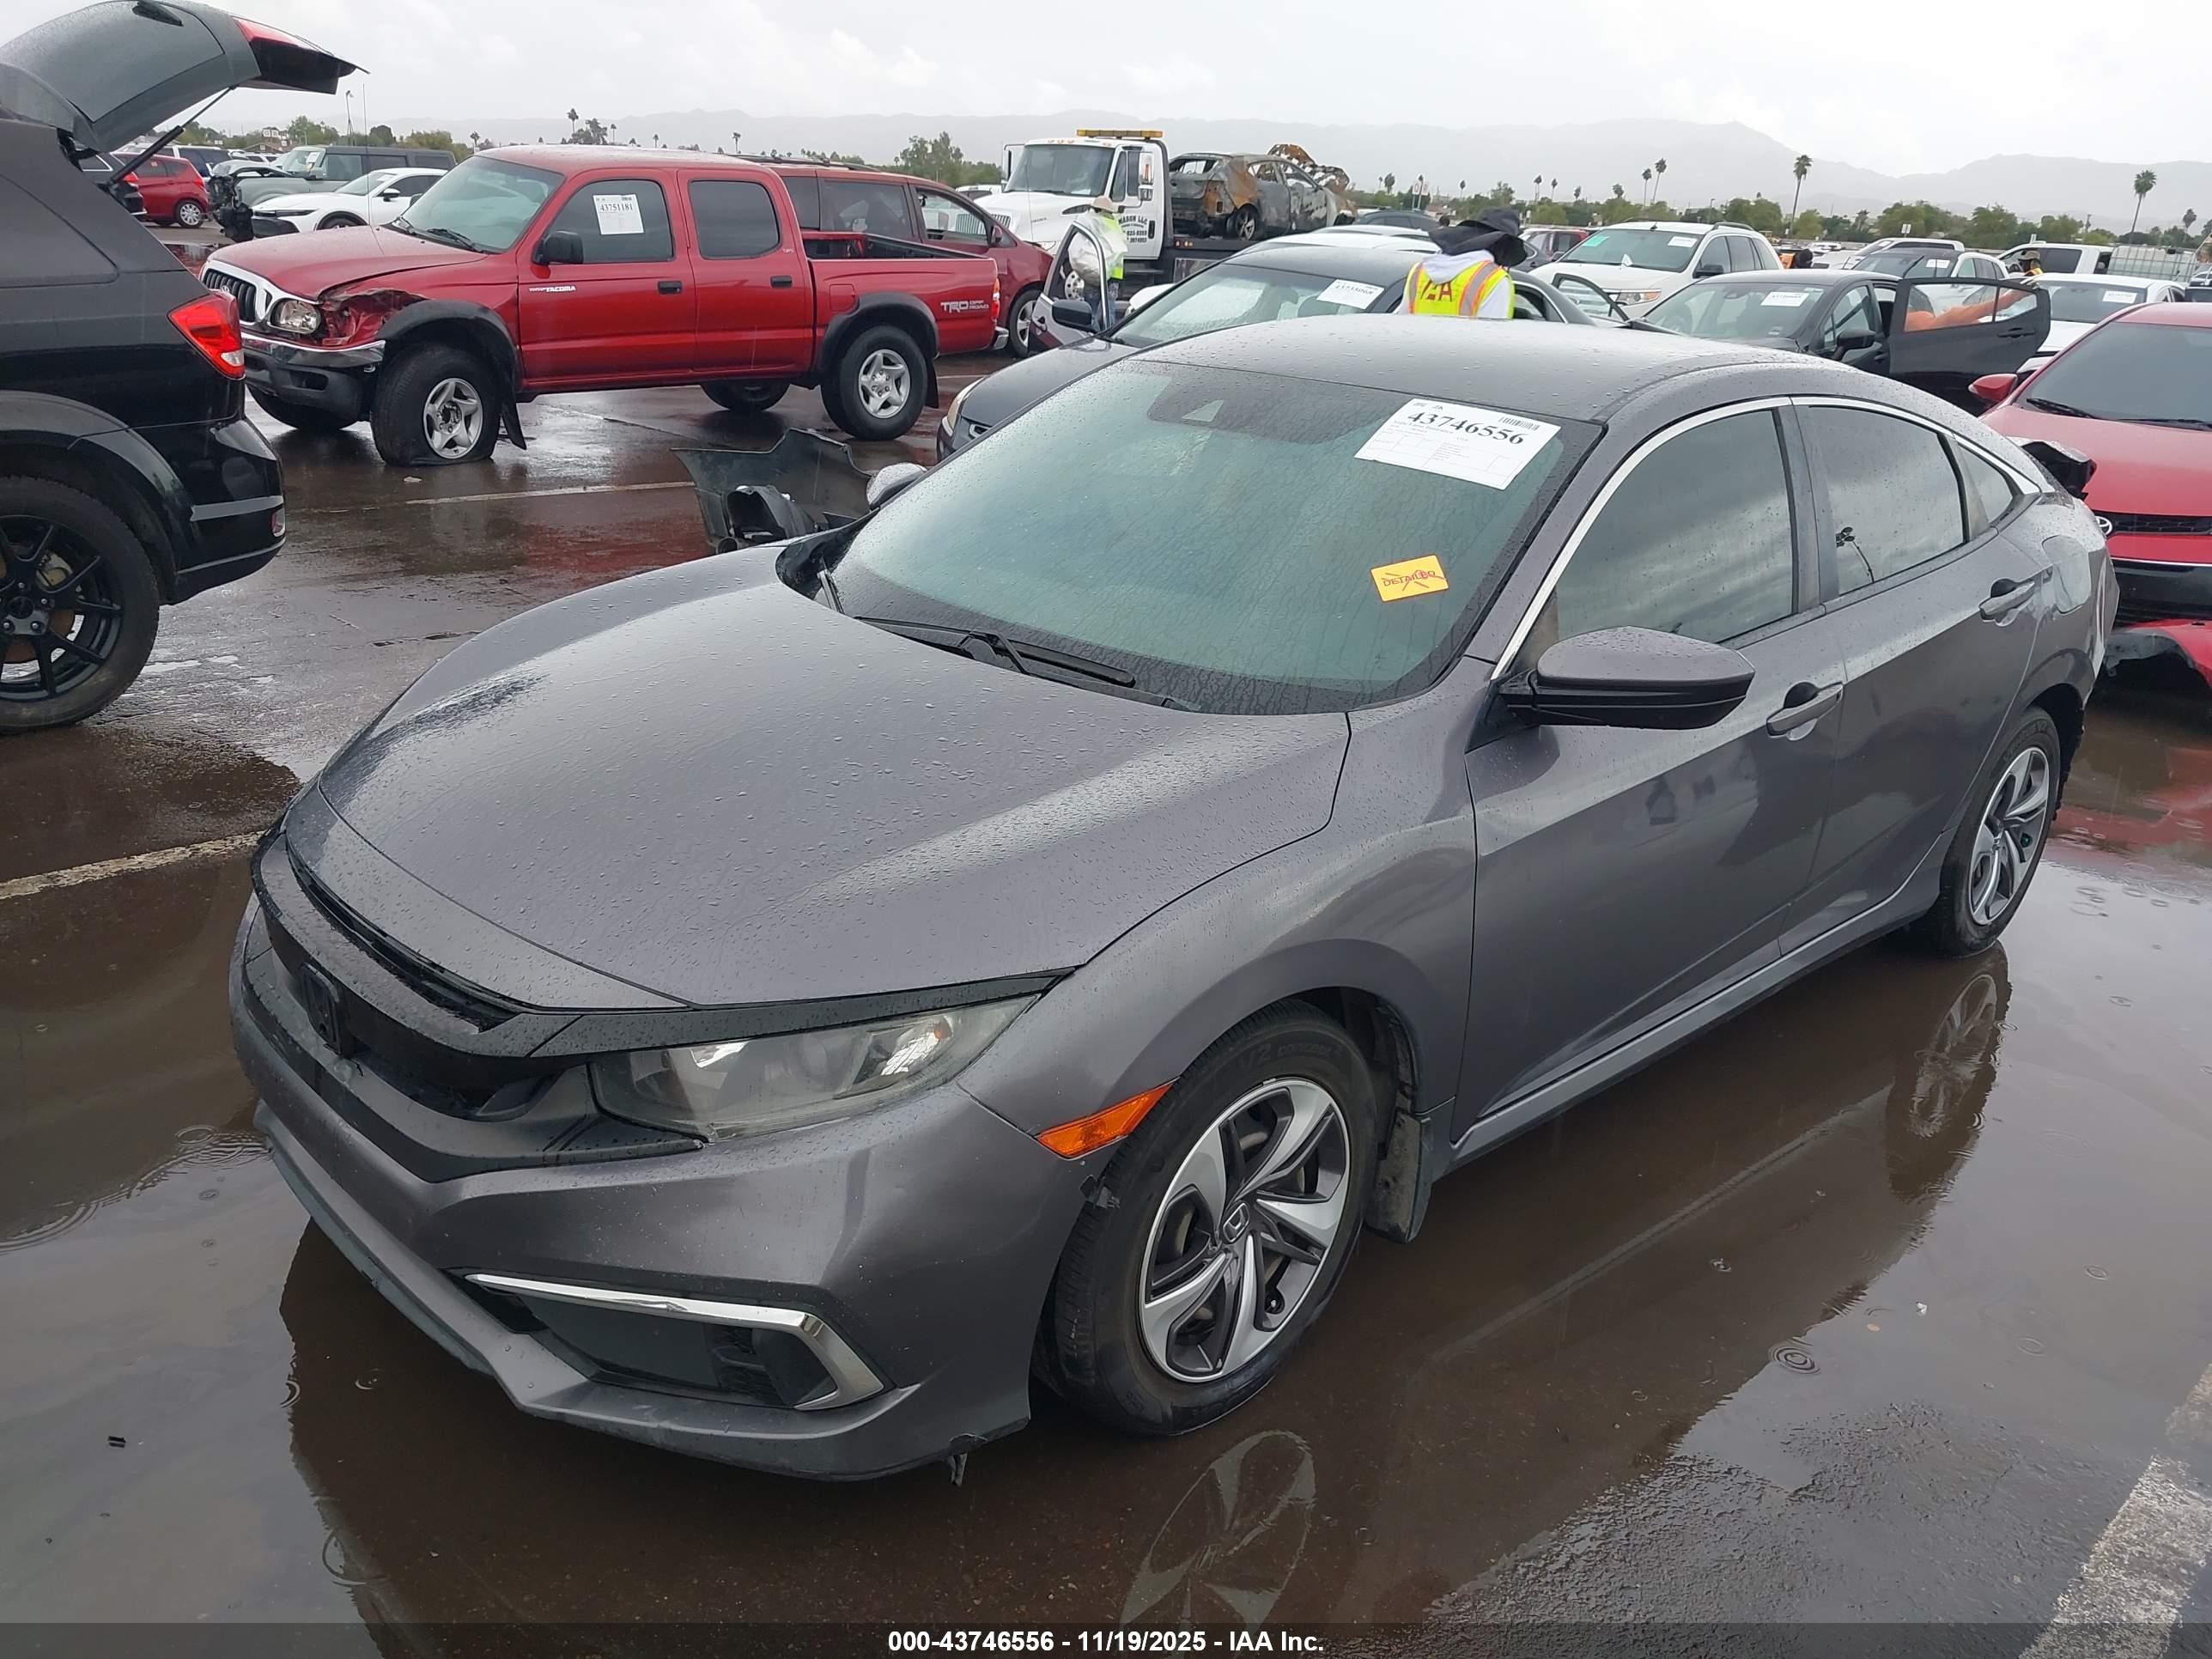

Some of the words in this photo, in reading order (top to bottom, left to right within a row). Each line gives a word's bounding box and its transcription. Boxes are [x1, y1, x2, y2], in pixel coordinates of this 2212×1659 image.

[599, 203, 633, 212] 43751181
[939, 301, 969, 313] TRD
[1407, 411, 1530, 445] 43746556
